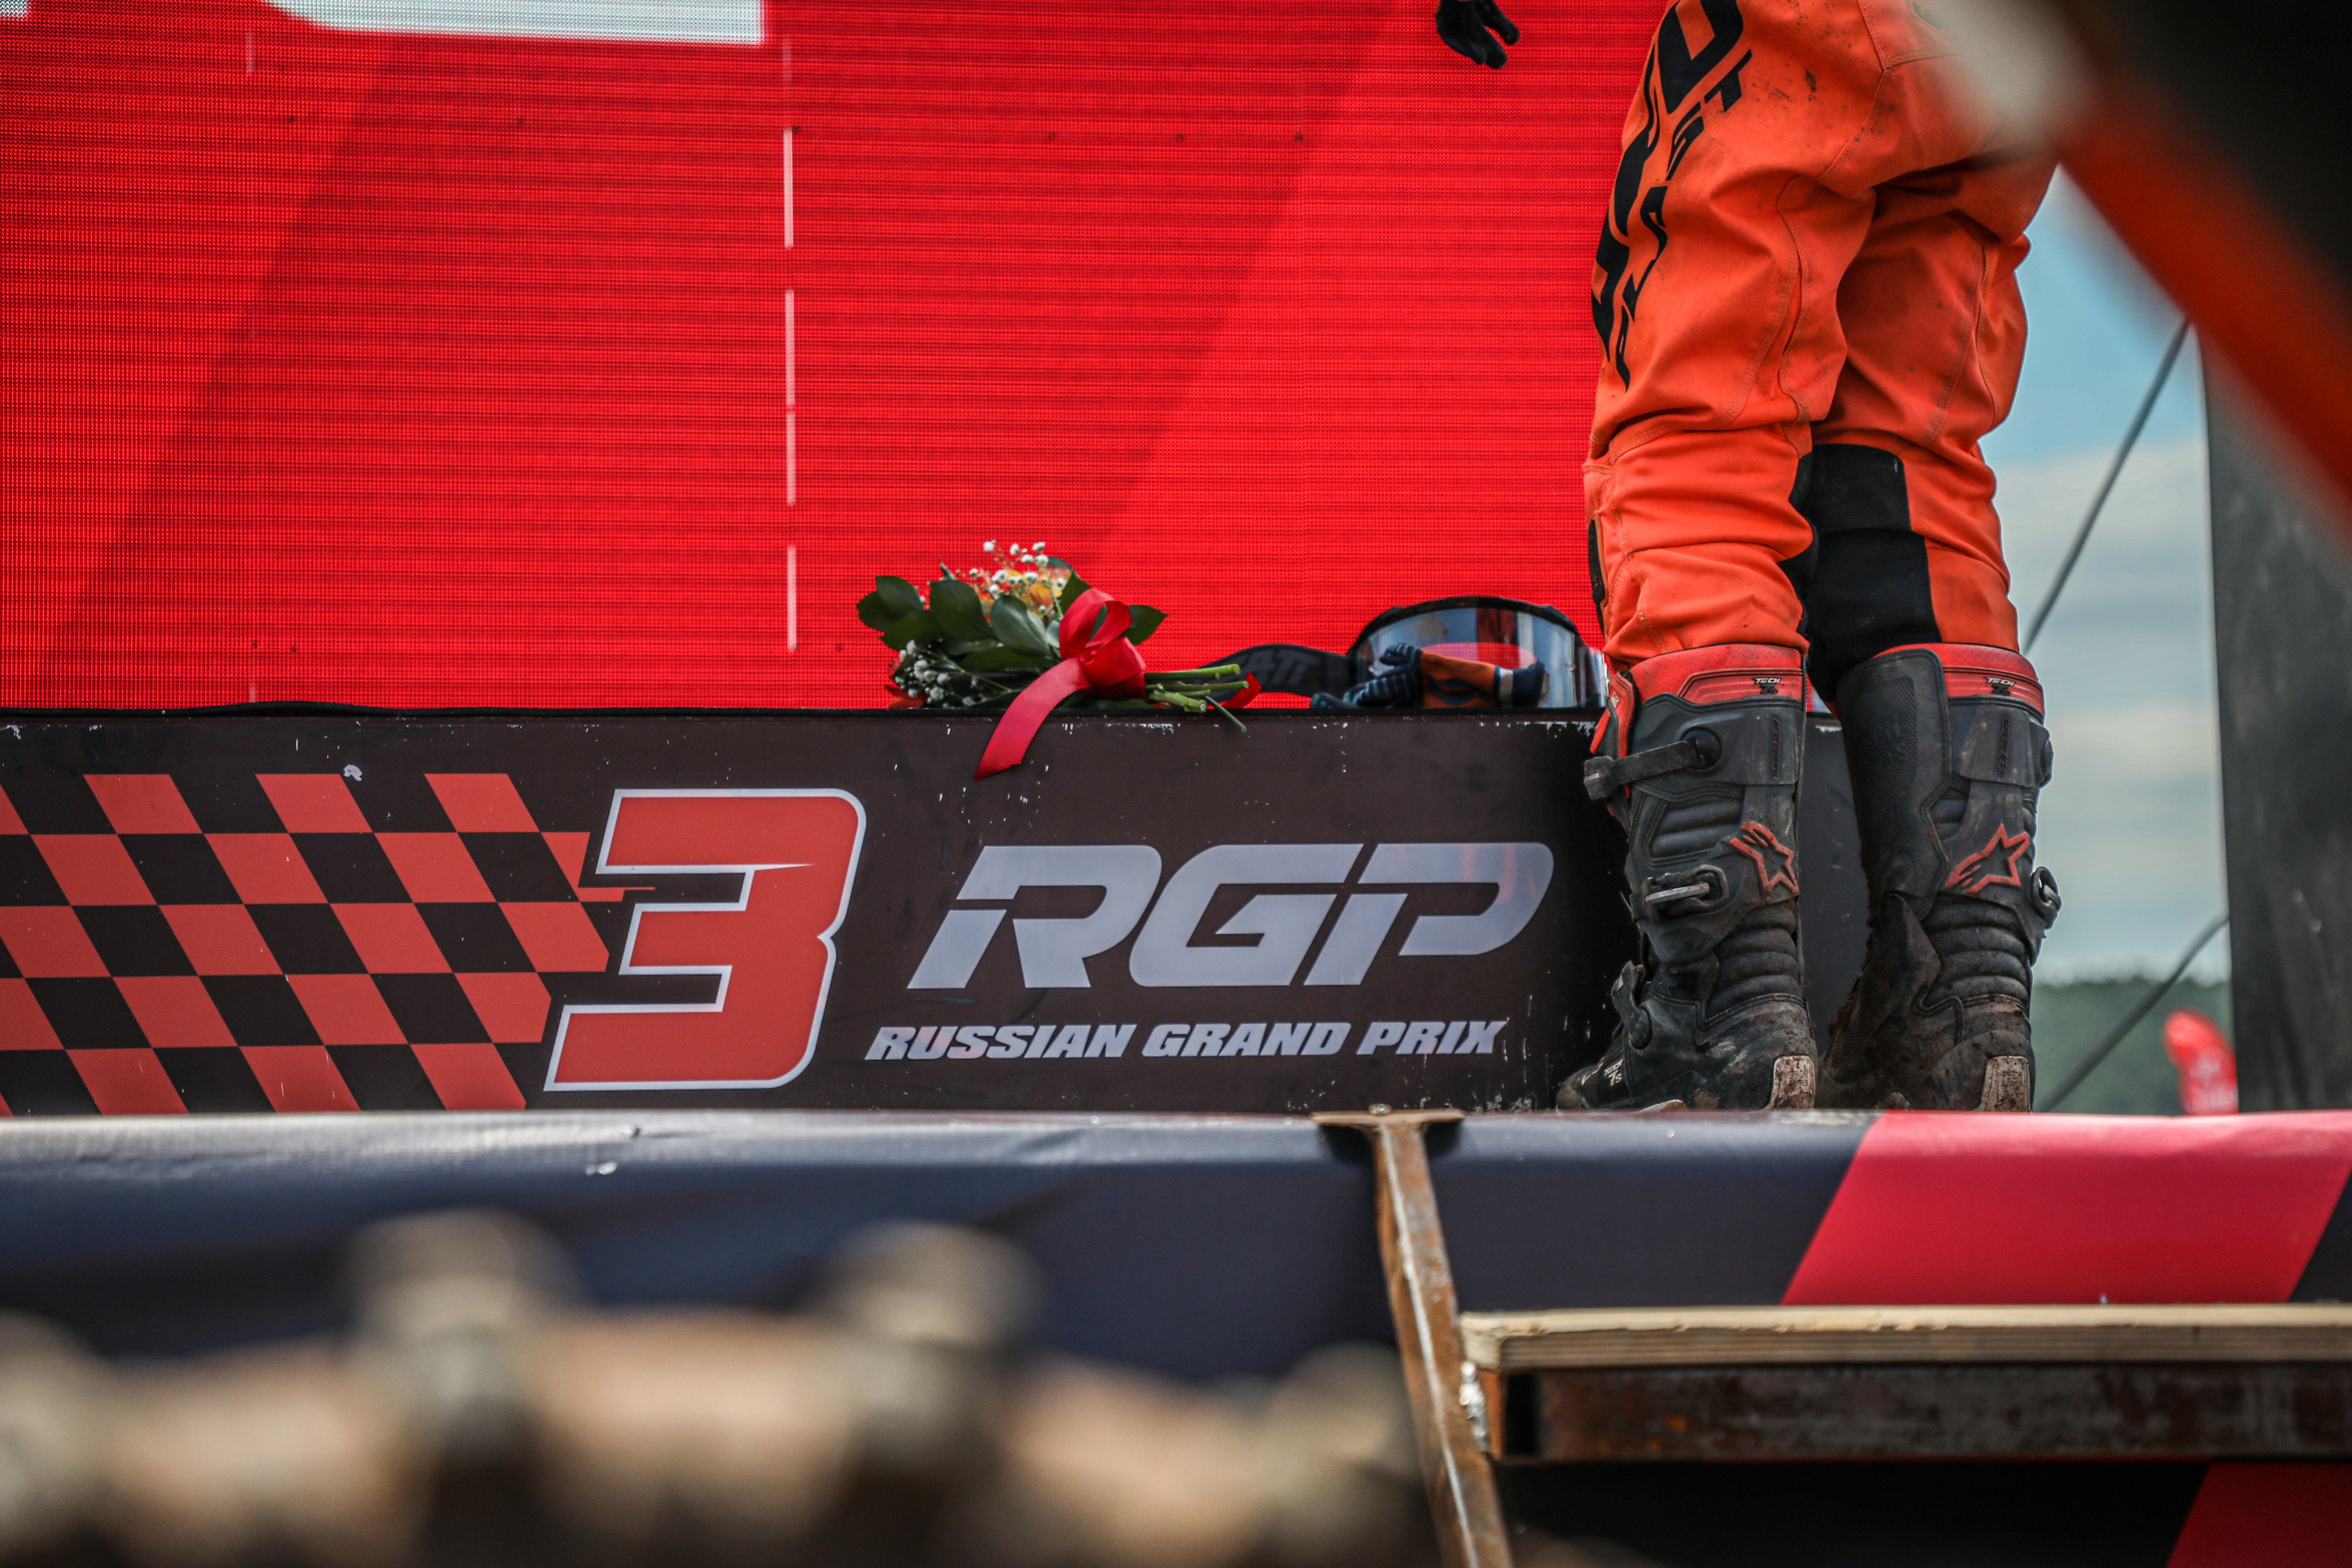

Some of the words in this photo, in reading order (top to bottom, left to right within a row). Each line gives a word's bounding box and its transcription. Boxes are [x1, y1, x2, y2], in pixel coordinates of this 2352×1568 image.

[544, 788, 867, 1091] 3
[908, 842, 1554, 989] RGP
[865, 1025, 1136, 1061] RUSSIAN
[1142, 1022, 1351, 1058] GRAND
[1356, 1020, 1507, 1056] PRIX
